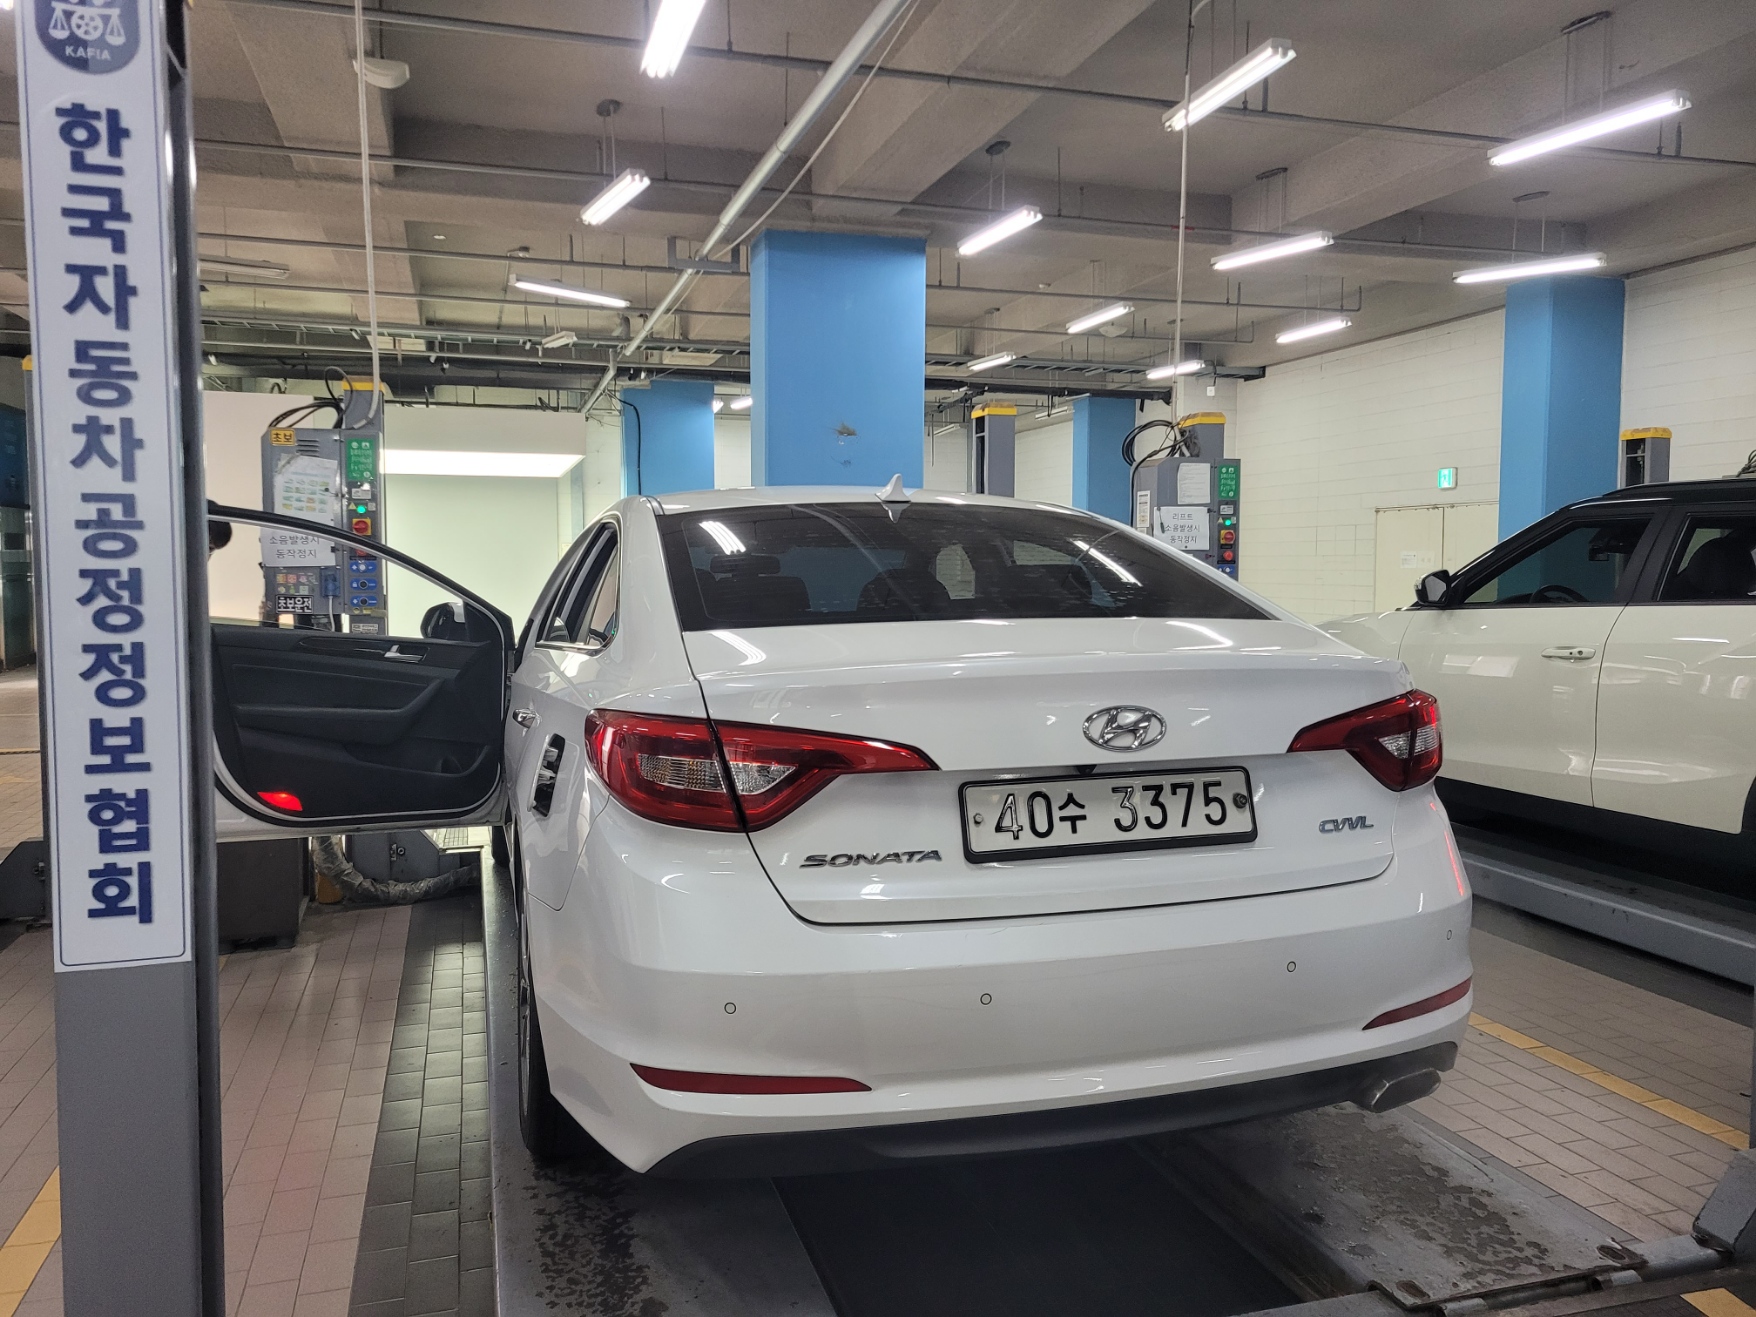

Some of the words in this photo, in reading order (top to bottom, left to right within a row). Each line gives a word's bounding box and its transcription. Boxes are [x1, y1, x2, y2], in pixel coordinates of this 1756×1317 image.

[65, 45, 111, 60] KAFIA
[273, 432, 292, 443] 초보
[55, 102, 152, 924] 한국자동차공정정보협회
[1172, 513, 1193, 521] 리프트
[1169, 535, 1198, 544] 동작정지
[275, 548, 317, 559] 동작정지
[277, 597, 312, 613] 초보운전
[994, 790, 1087, 840] 40수
[1111, 780, 1227, 832] 3375
[799, 850, 943, 869] SONATA
